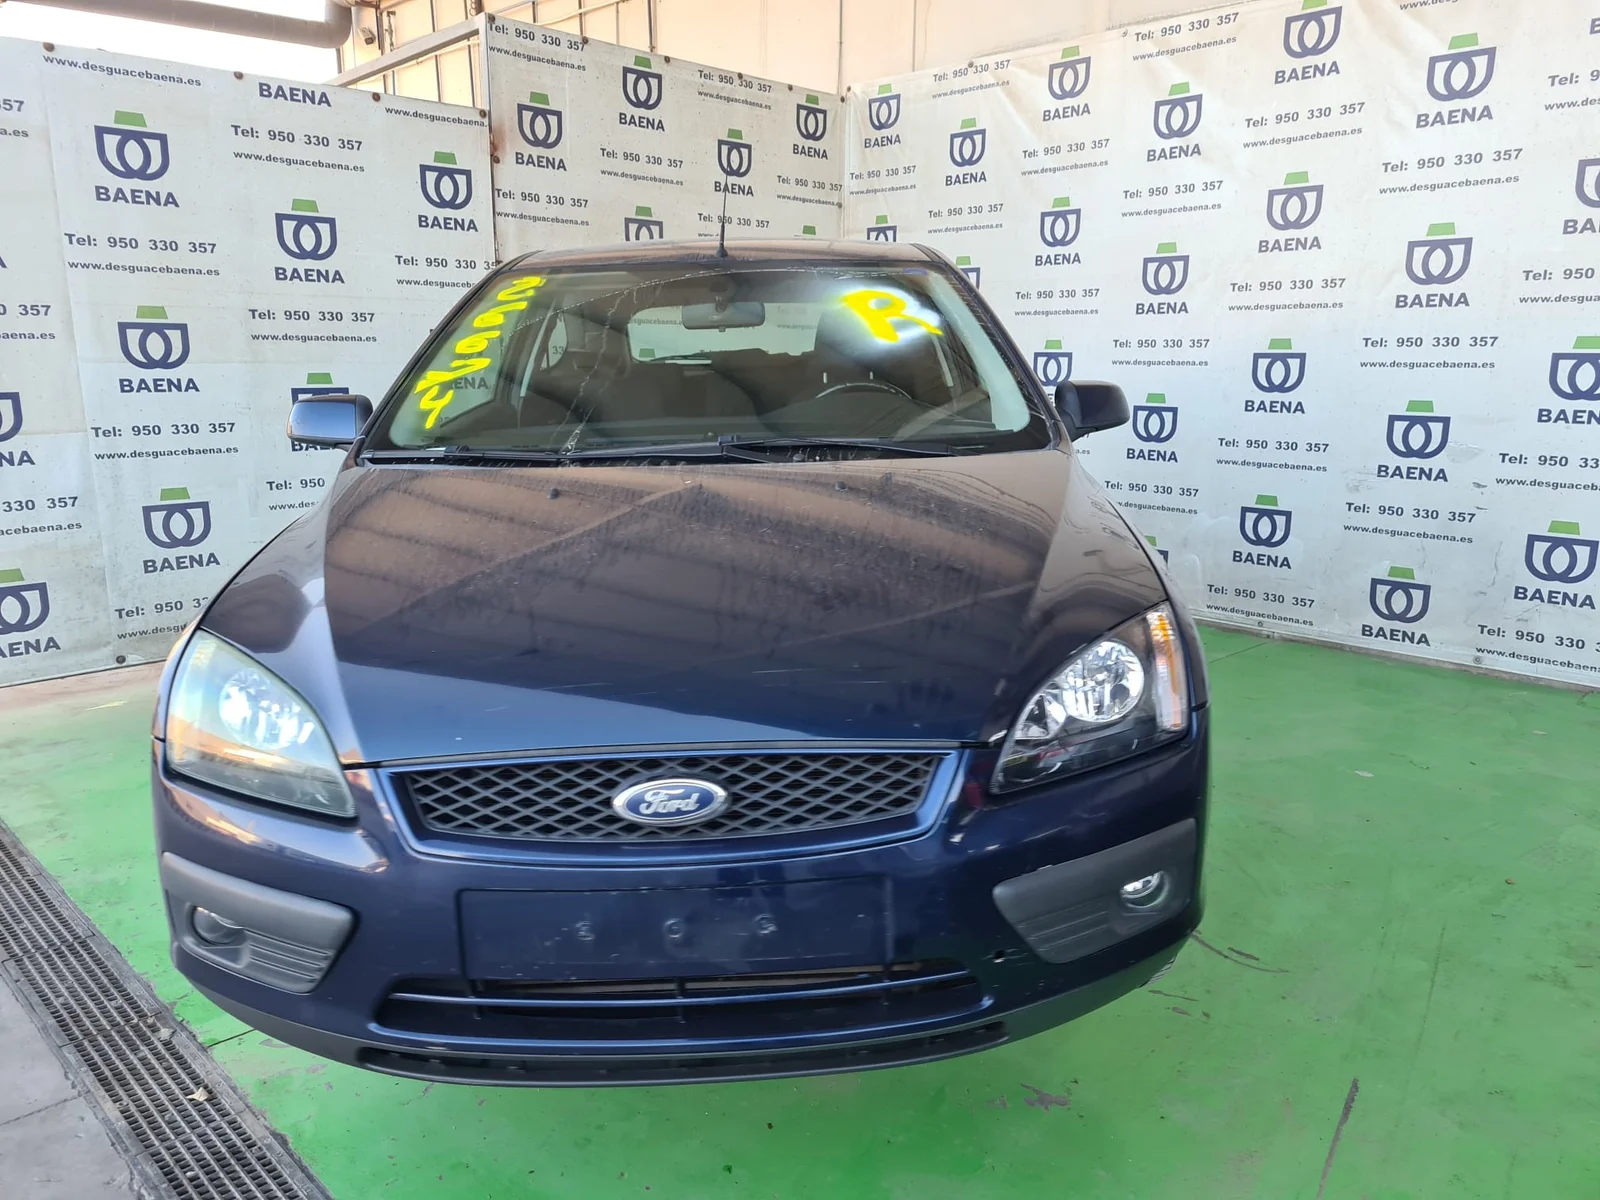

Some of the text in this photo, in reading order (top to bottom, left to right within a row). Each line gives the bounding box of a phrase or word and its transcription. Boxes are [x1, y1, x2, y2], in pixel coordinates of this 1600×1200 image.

[1135, 12, 1239, 42] Tel: 950 330 357
[515, 28, 561, 46] 950 330
[1133, 36, 1236, 61] www.desguacebaena.es
[43, 55, 201, 86] www.desguacebaena.es
[1275, 61, 1340, 84] BAENA
[698, 70, 772, 93] Tel: 950 357
[1548, 73, 1579, 86] Tel:
[259, 82, 331, 107] BAENA
[1043, 103, 1090, 122] BAENA
[1245, 102, 1365, 128] Tel: 950 330 357
[1416, 105, 1493, 128] BAENA
[619, 112, 665, 131] BAENA
[231, 125, 362, 151] Tel: 950 330 357
[864, 134, 901, 148] BAENA
[1243, 128, 1362, 148] www.desguacebaena.es
[793, 144, 828, 160] BAENA
[1022, 139, 1110, 158] Tel: 950 330 357
[1147, 144, 1201, 162] BAENA
[233, 152, 364, 172] www.desguacebaena.es
[515, 152, 567, 171] BAENA
[600, 148, 683, 168] Tel: 950 330 357
[1382, 148, 1523, 173] Tel: 950 330 357
[946, 171, 986, 186] BAENA
[1379, 176, 1519, 194] www.desguacebaena.es
[95, 186, 179, 207] BAENA
[714, 182, 754, 196] BAENA
[1123, 180, 1223, 199] Tel: 950 330 357
[495, 189, 588, 208] Tel: 950 330 357
[928, 203, 1003, 218] Tel: 950 330 357
[1121, 204, 1221, 217] www.desguacebaena.es
[418, 215, 478, 232] BAENA
[64, 233, 216, 253] Tel: 950 330 357
[1258, 236, 1321, 253] BAENA
[395, 255, 476, 269] Tel: 950 330
[1035, 253, 1081, 266] BAENA
[68, 262, 219, 275] www.desguacebaena.es
[275, 267, 345, 283] BAENA
[1523, 268, 1595, 281] Tel: 950
[1230, 278, 1346, 292] Tel: 950 330 357
[1136, 302, 1188, 314] BAENA
[1228, 302, 1343, 311] www.desguacebaena.es
[1395, 293, 1470, 308] BAENA
[18, 305, 51, 316] 357
[249, 309, 374, 322] Tel: 950 330 357
[251, 333, 376, 343] www.desguacebaena.es
[1113, 339, 1209, 348] Tel: 950 330 357
[1363, 337, 1498, 347] Tel: 950 330 357
[1360, 360, 1495, 369] www.desguacebaena.es
[119, 378, 200, 393] BAENA
[1245, 400, 1305, 414] BAENA
[91, 423, 235, 437] Tel: 950 330 357
[95, 447, 238, 459] www.desguacebaena.es
[1218, 438, 1329, 452] Tel: 950 330 357
[1127, 448, 1178, 462] BAENA
[1499, 453, 1568, 467] Tel: 950
[1217, 459, 1327, 472] www.desguacebaena.es
[1377, 465, 1448, 482] BAENA
[266, 478, 325, 490] Tel: 950
[1105, 481, 1198, 497] Tel: 950 330 357
[2, 496, 78, 512] 330 357
[1346, 502, 1476, 523] Tel: 950 330 357
[1344, 525, 1473, 543] www.desguacebaena.es
[143, 553, 220, 574] BAENA
[1233, 551, 1291, 569] BAENA
[1207, 584, 1314, 608] Tel: 950 330 357
[1514, 586, 1595, 609] BAENA
[114, 606, 145, 619] Tel:
[155, 601, 183, 613] 950
[1206, 605, 1313, 628] www.desguacebaena.es
[1362, 624, 1430, 646] BAENA
[1478, 624, 1585, 649] Tel: 950 330
[638, 788, 700, 814] Ford
